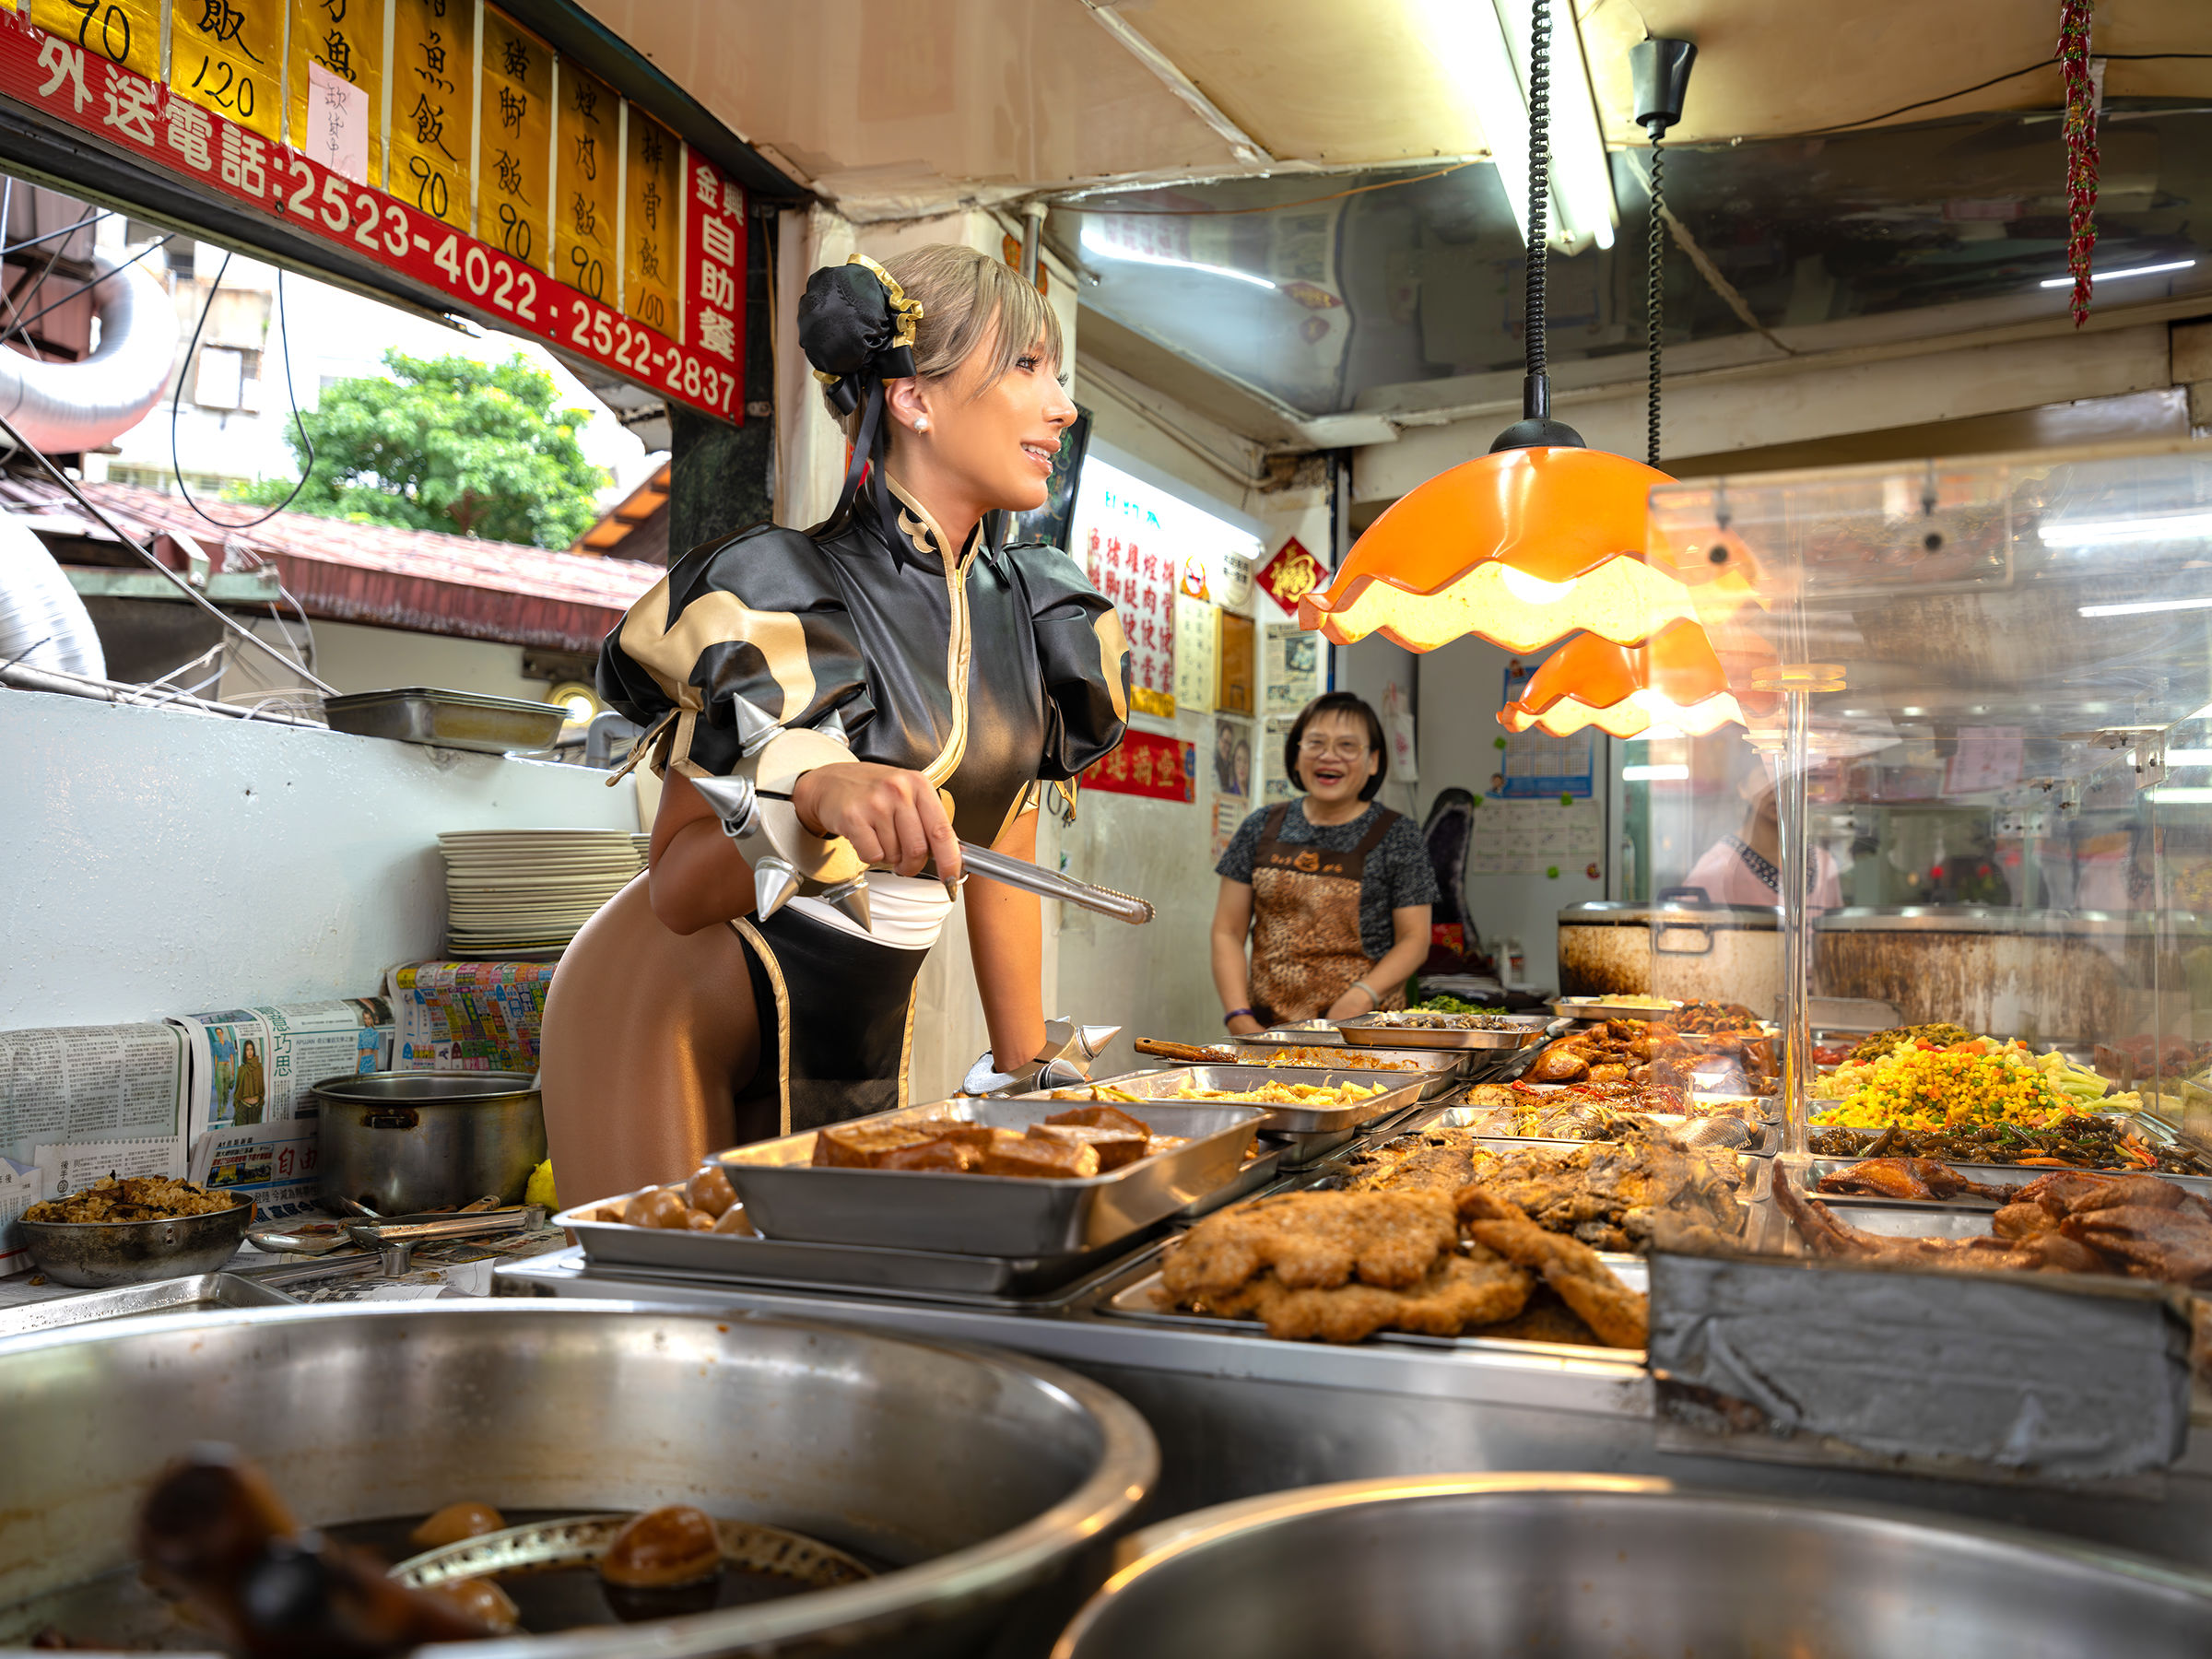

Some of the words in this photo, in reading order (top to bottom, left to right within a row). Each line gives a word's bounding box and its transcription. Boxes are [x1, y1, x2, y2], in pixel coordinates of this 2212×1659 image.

[192, 54, 253, 117] 120
[409, 155, 449, 218] 90
[640, 126, 667, 288] 排骨飯
[499, 203, 531, 261] 90
[288, 160, 538, 323] 2523-4022
[571, 300, 736, 418] 2522-2837
[571, 246, 604, 300] 90
[698, 215, 735, 362] 自助餐
[637, 288, 665, 327] 100
